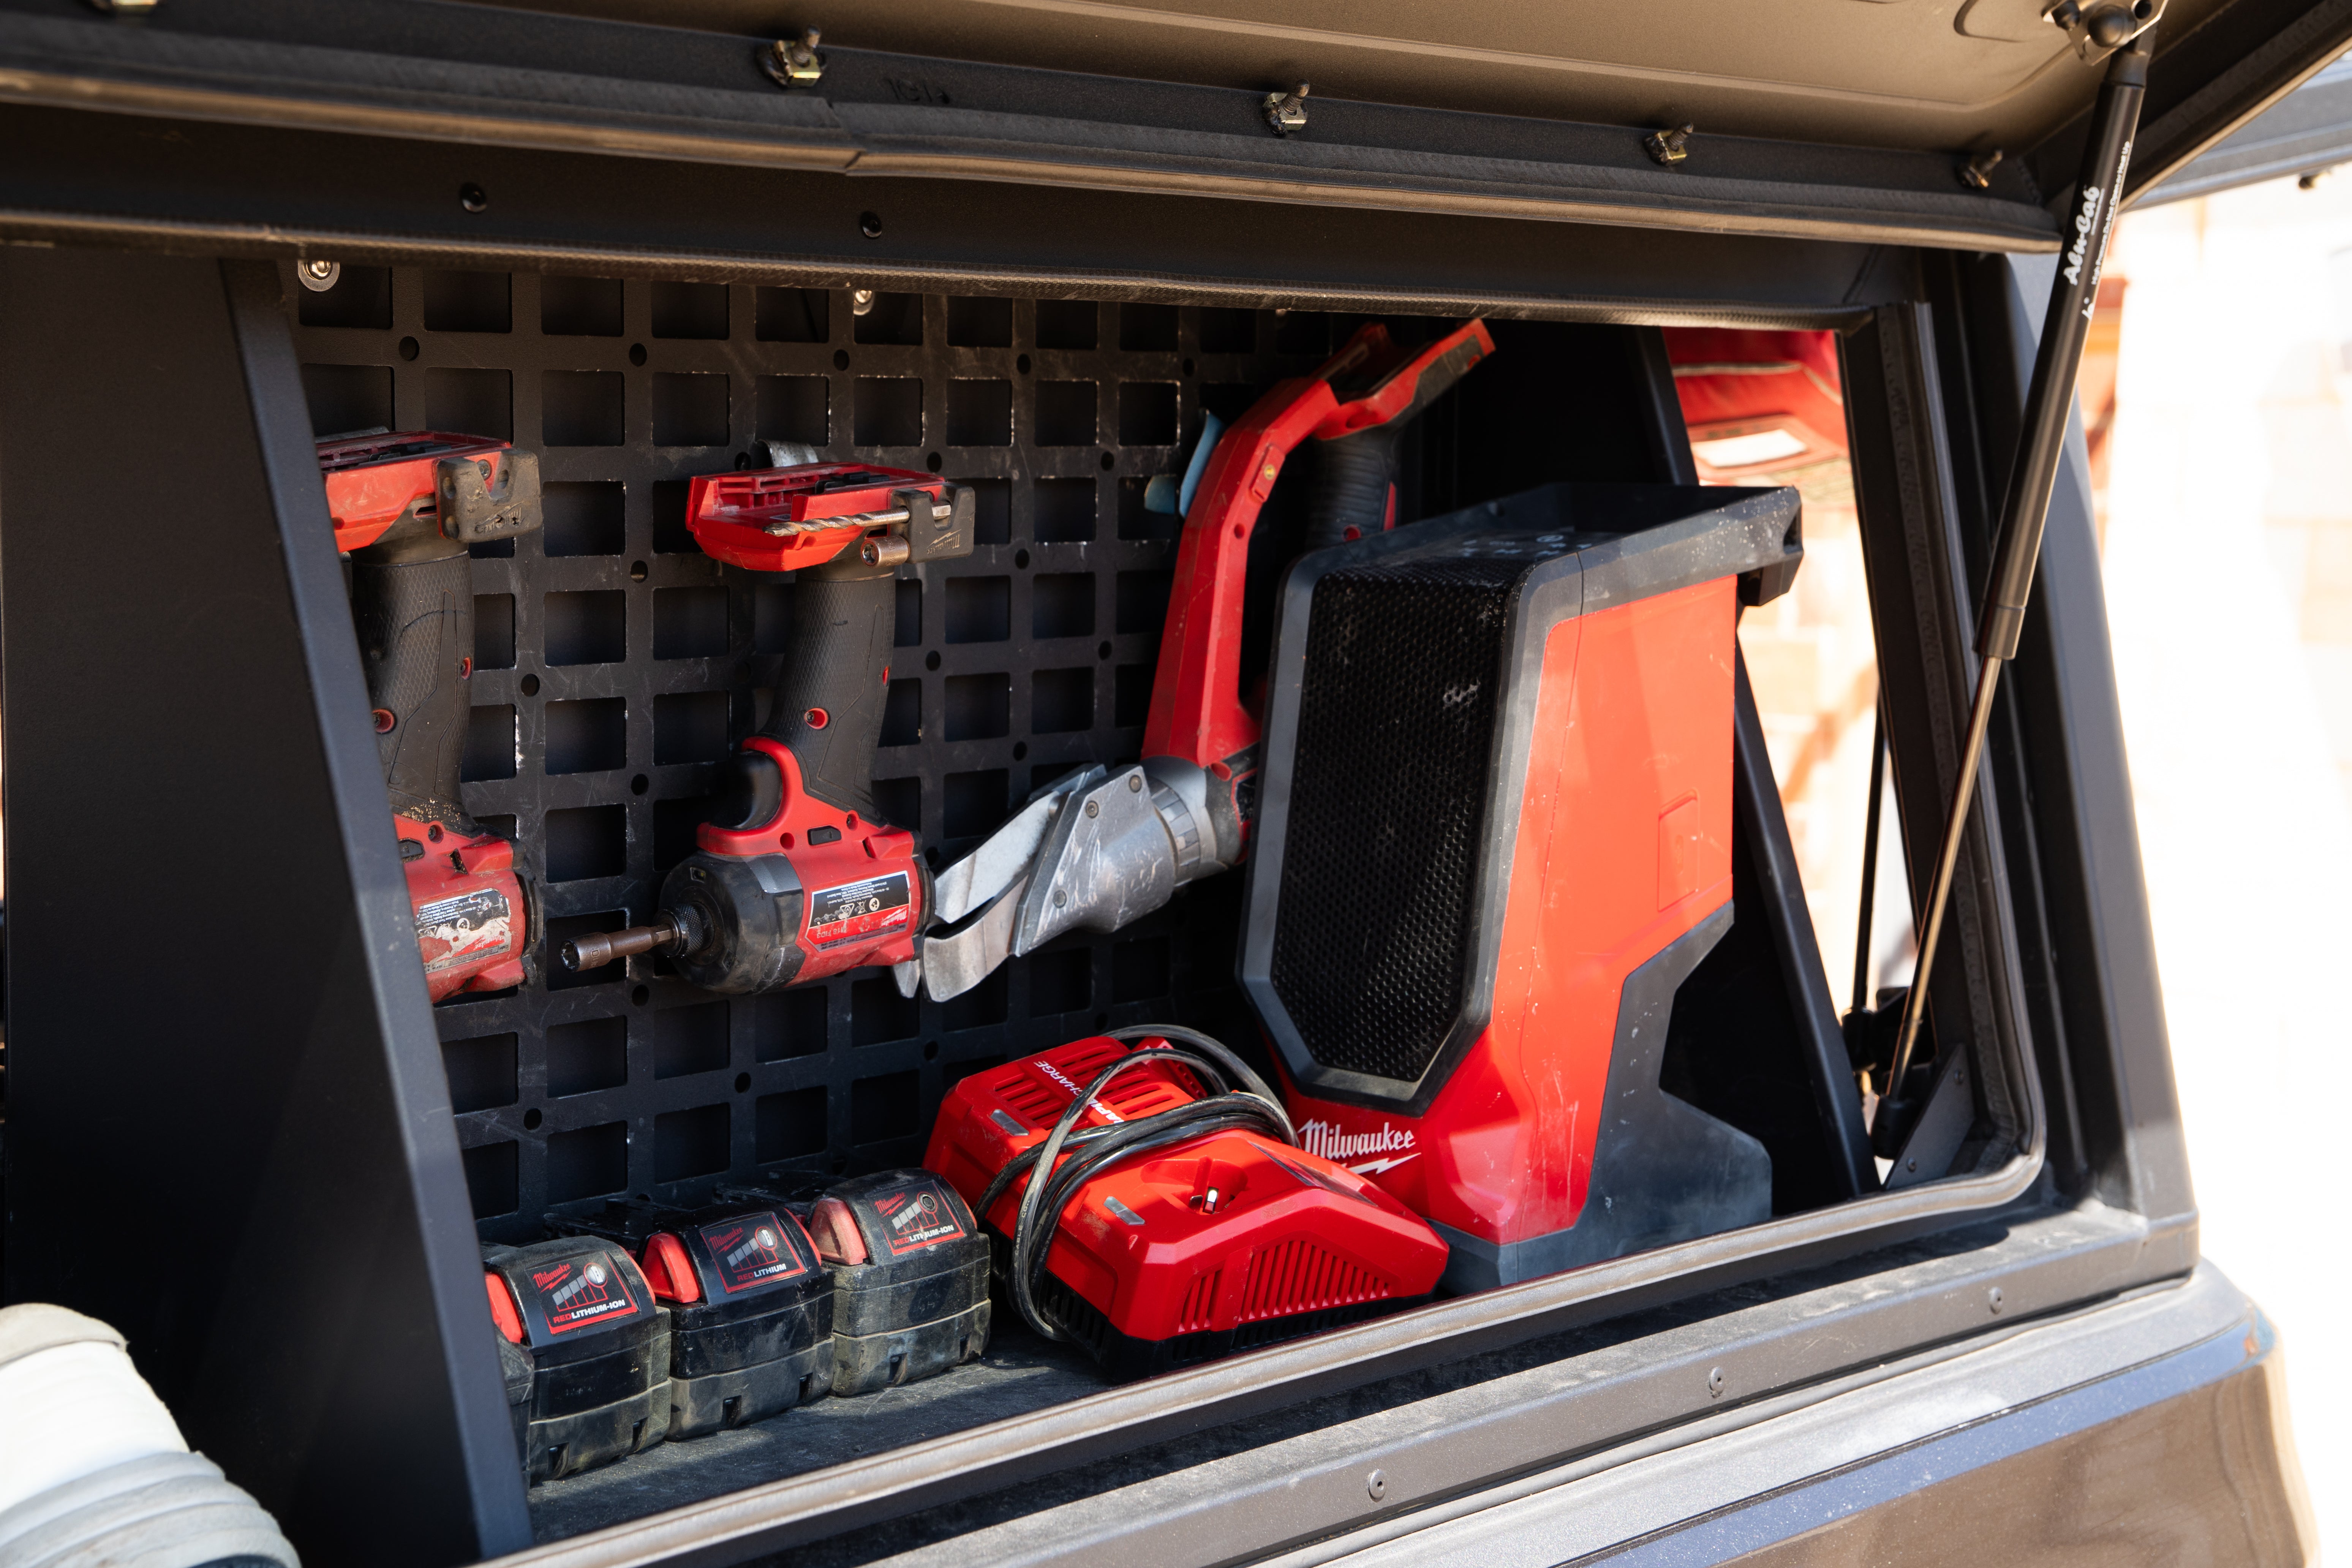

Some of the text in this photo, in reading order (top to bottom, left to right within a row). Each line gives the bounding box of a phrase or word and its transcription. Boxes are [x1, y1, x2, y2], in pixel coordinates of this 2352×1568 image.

[2063, 187, 2100, 286] Alu-Cab
[816, 930, 831, 939] FID3
[1297, 1118, 1416, 1160] Milwaukee
[874, 1192, 906, 1214] Milwaukee
[709, 1227, 743, 1250] Milwaukee
[532, 1263, 572, 1288] Milwaukee
[737, 1263, 787, 1282] REDLITHIUM
[553, 1299, 626, 1324] REDLITHIUM-ION
